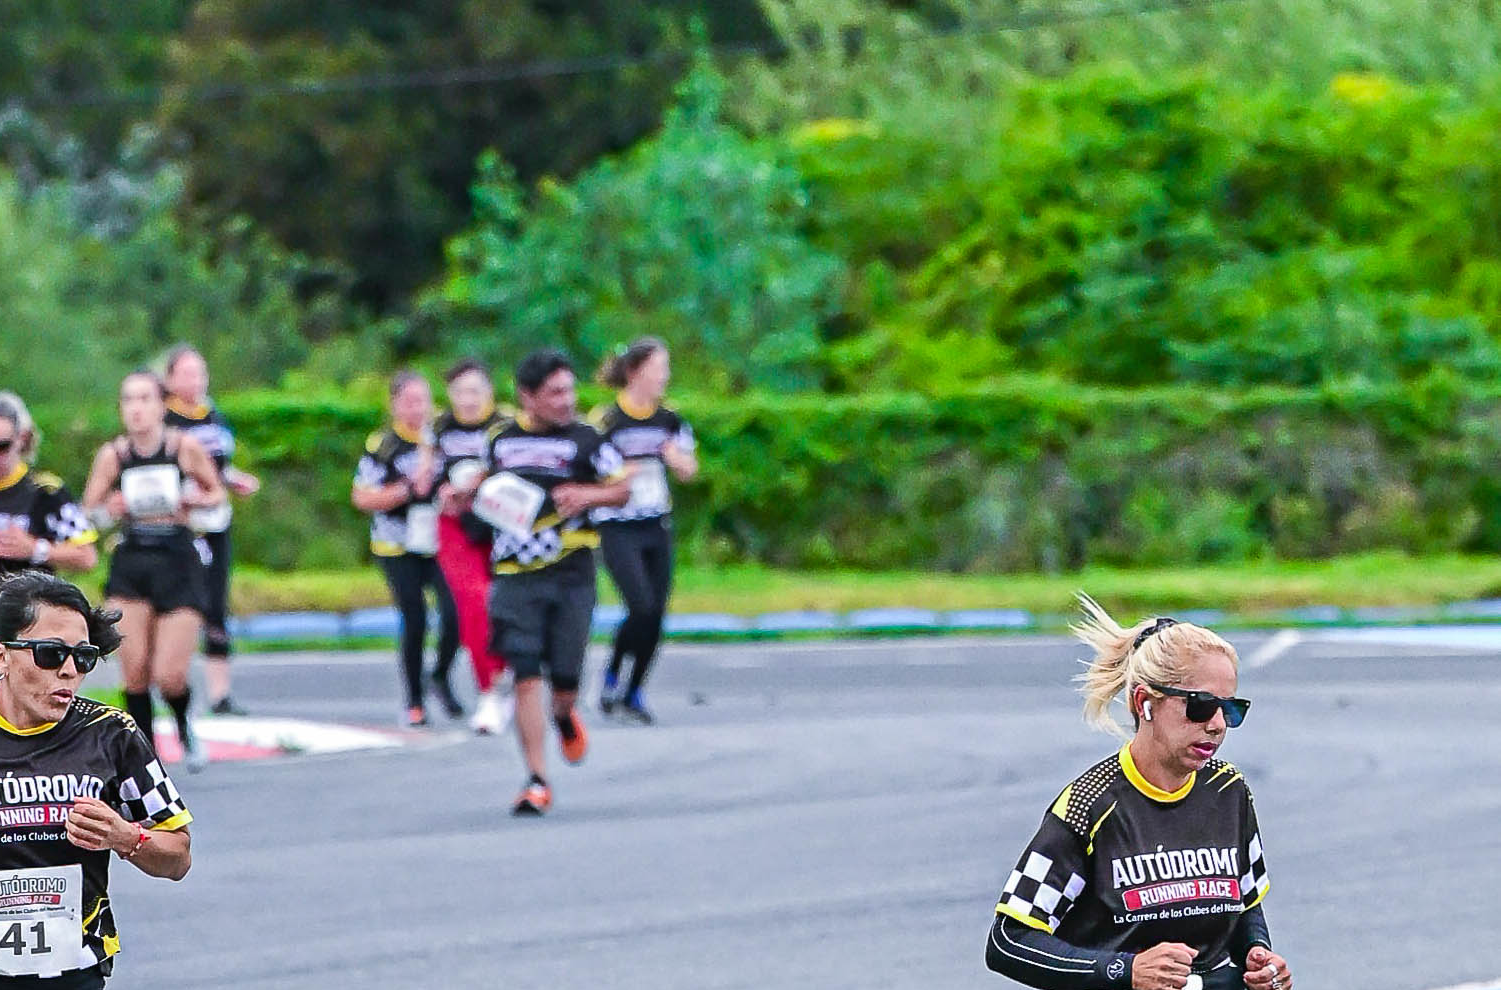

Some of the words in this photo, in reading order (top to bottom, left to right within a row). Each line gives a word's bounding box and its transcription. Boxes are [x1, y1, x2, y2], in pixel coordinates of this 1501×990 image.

[49, 806, 75, 824] RA
[0, 833, 13, 843] de
[14, 832, 26, 841] los
[29, 830, 57, 841] Clubes
[32, 894, 54, 904] RACE
[1139, 884, 1196, 906] RUNNING
[1198, 881, 1233, 897] RACE
[1113, 914, 1125, 924] La
[1125, 912, 1158, 922] Carrera
[1159, 908, 1169, 918] de
[1171, 908, 1182, 917] los
[1183, 905, 1209, 916] Clubes
[1210, 903, 1224, 913] del
[0, 921, 52, 956] 41
